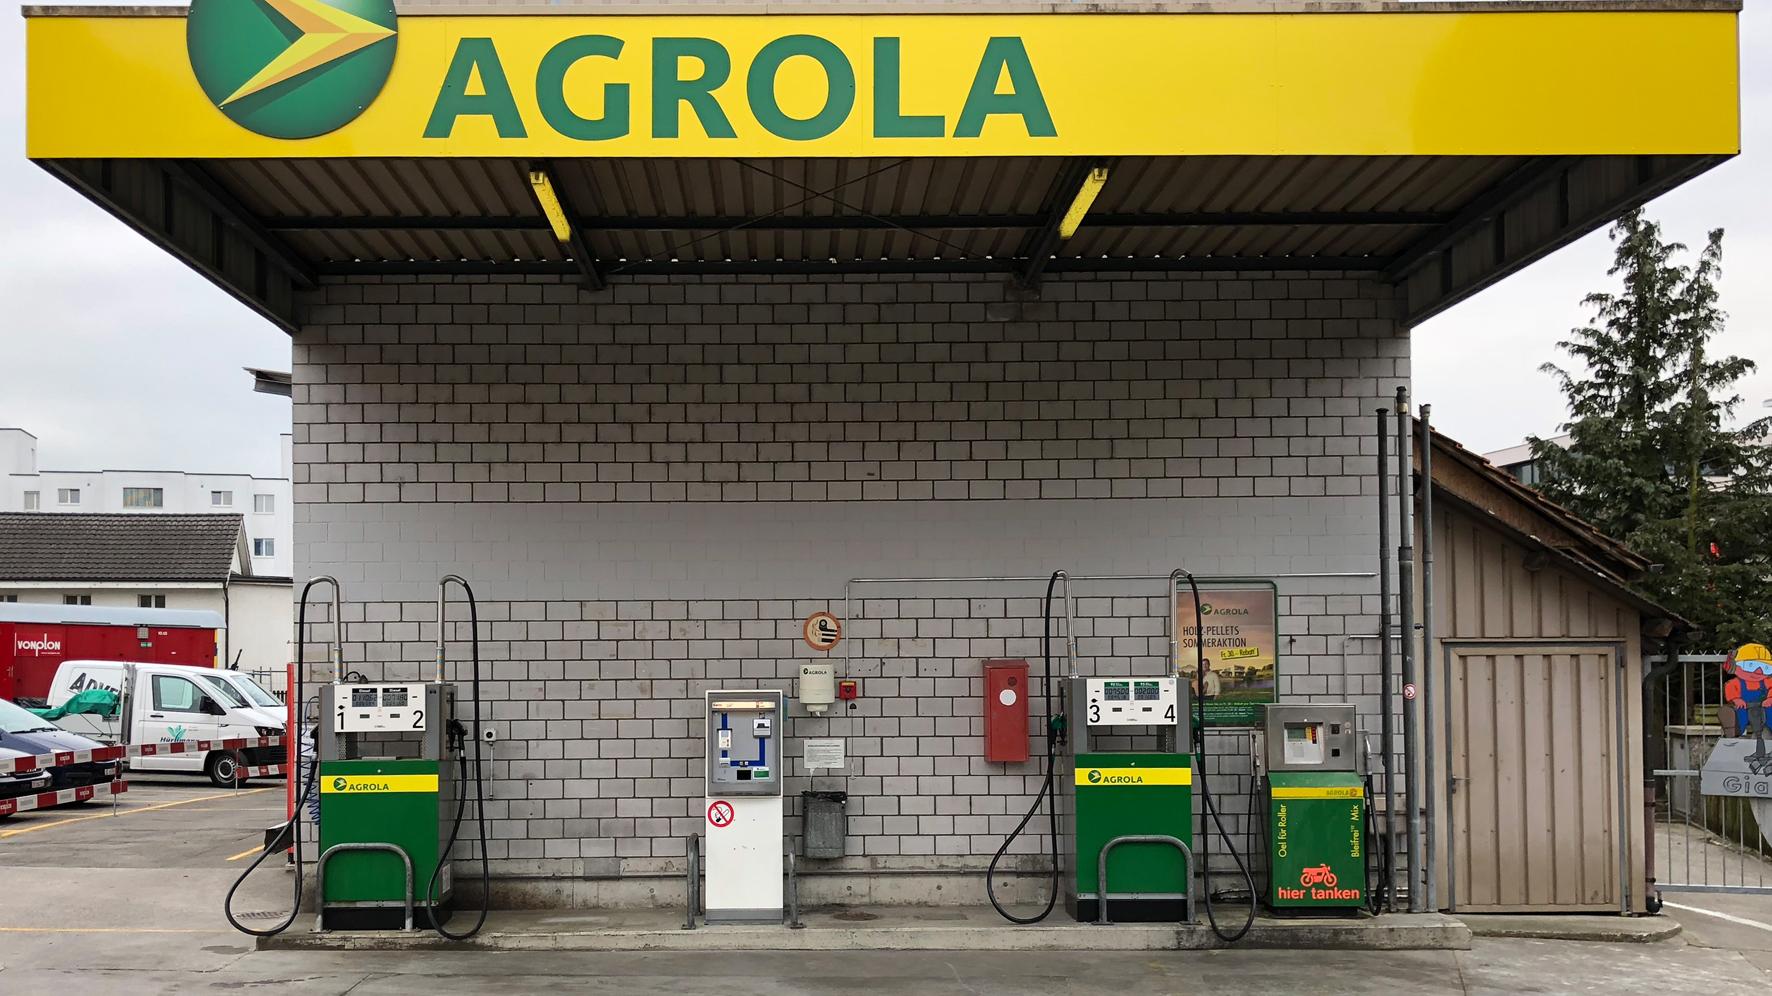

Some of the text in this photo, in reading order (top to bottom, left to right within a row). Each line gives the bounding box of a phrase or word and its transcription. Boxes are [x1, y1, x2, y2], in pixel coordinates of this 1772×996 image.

[422, 34, 1058, 141] AGROLA
[1213, 608, 1249, 616] AGROLA
[1183, 626, 1240, 636] HOL-PELLETS
[337, 712, 344, 730] 1
[412, 710, 424, 728] 2
[1089, 704, 1101, 723] 3
[1163, 704, 1176, 723] 4
[348, 783, 390, 791] AGROLA
[1102, 775, 1144, 783] AGROLA
[1350, 804, 1359, 821] Mix
[1277, 804, 1287, 857] Oel für Roller
[1278, 886, 1360, 900] hier tanken
